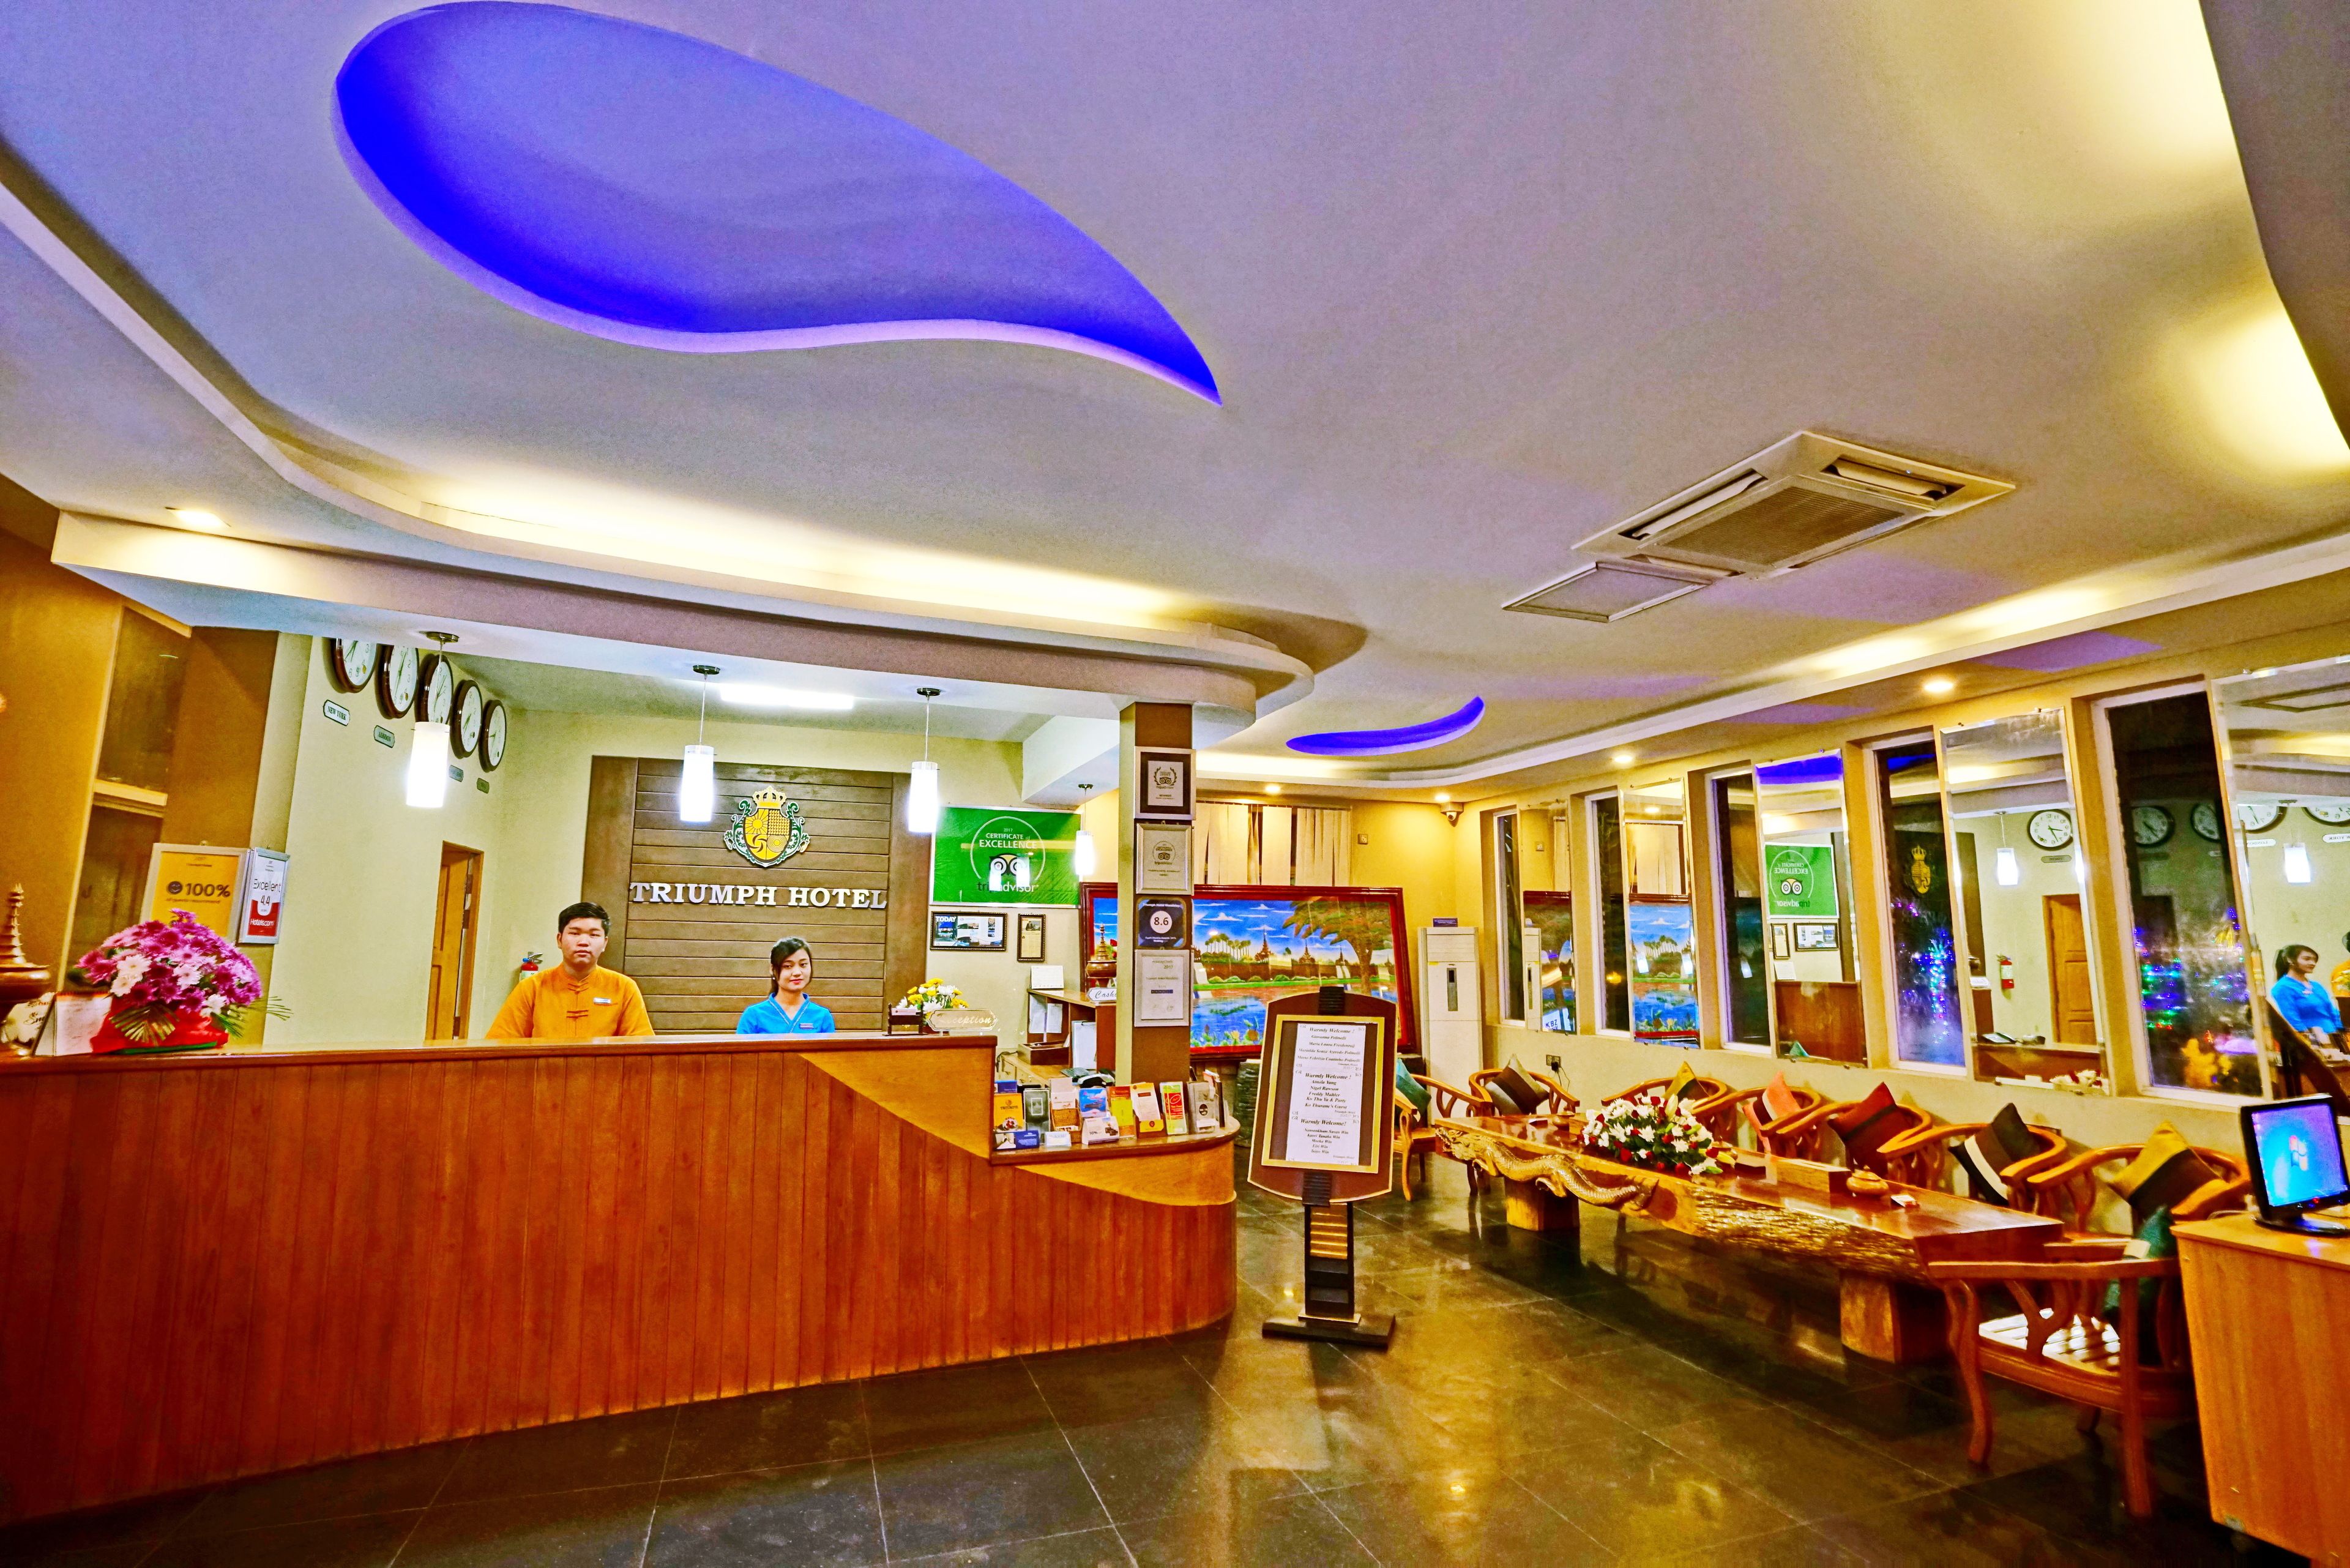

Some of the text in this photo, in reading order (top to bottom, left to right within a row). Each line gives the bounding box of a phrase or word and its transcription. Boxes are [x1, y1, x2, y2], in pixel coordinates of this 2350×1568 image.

[327, 706, 346, 720] NEW YORK
[378, 731, 392, 742] LONDON
[979, 840, 1037, 848] EXCELLENCE
[186, 883, 230, 897] 100%
[253, 879, 281, 892] Excellent
[977, 881, 1035, 892] tridvisor
[261, 895, 270, 906] 4.4
[630, 883, 887, 909] TRIUMPH HOTEL
[1154, 917, 1168, 925] 8.6
[937, 1014, 991, 1026] eception
